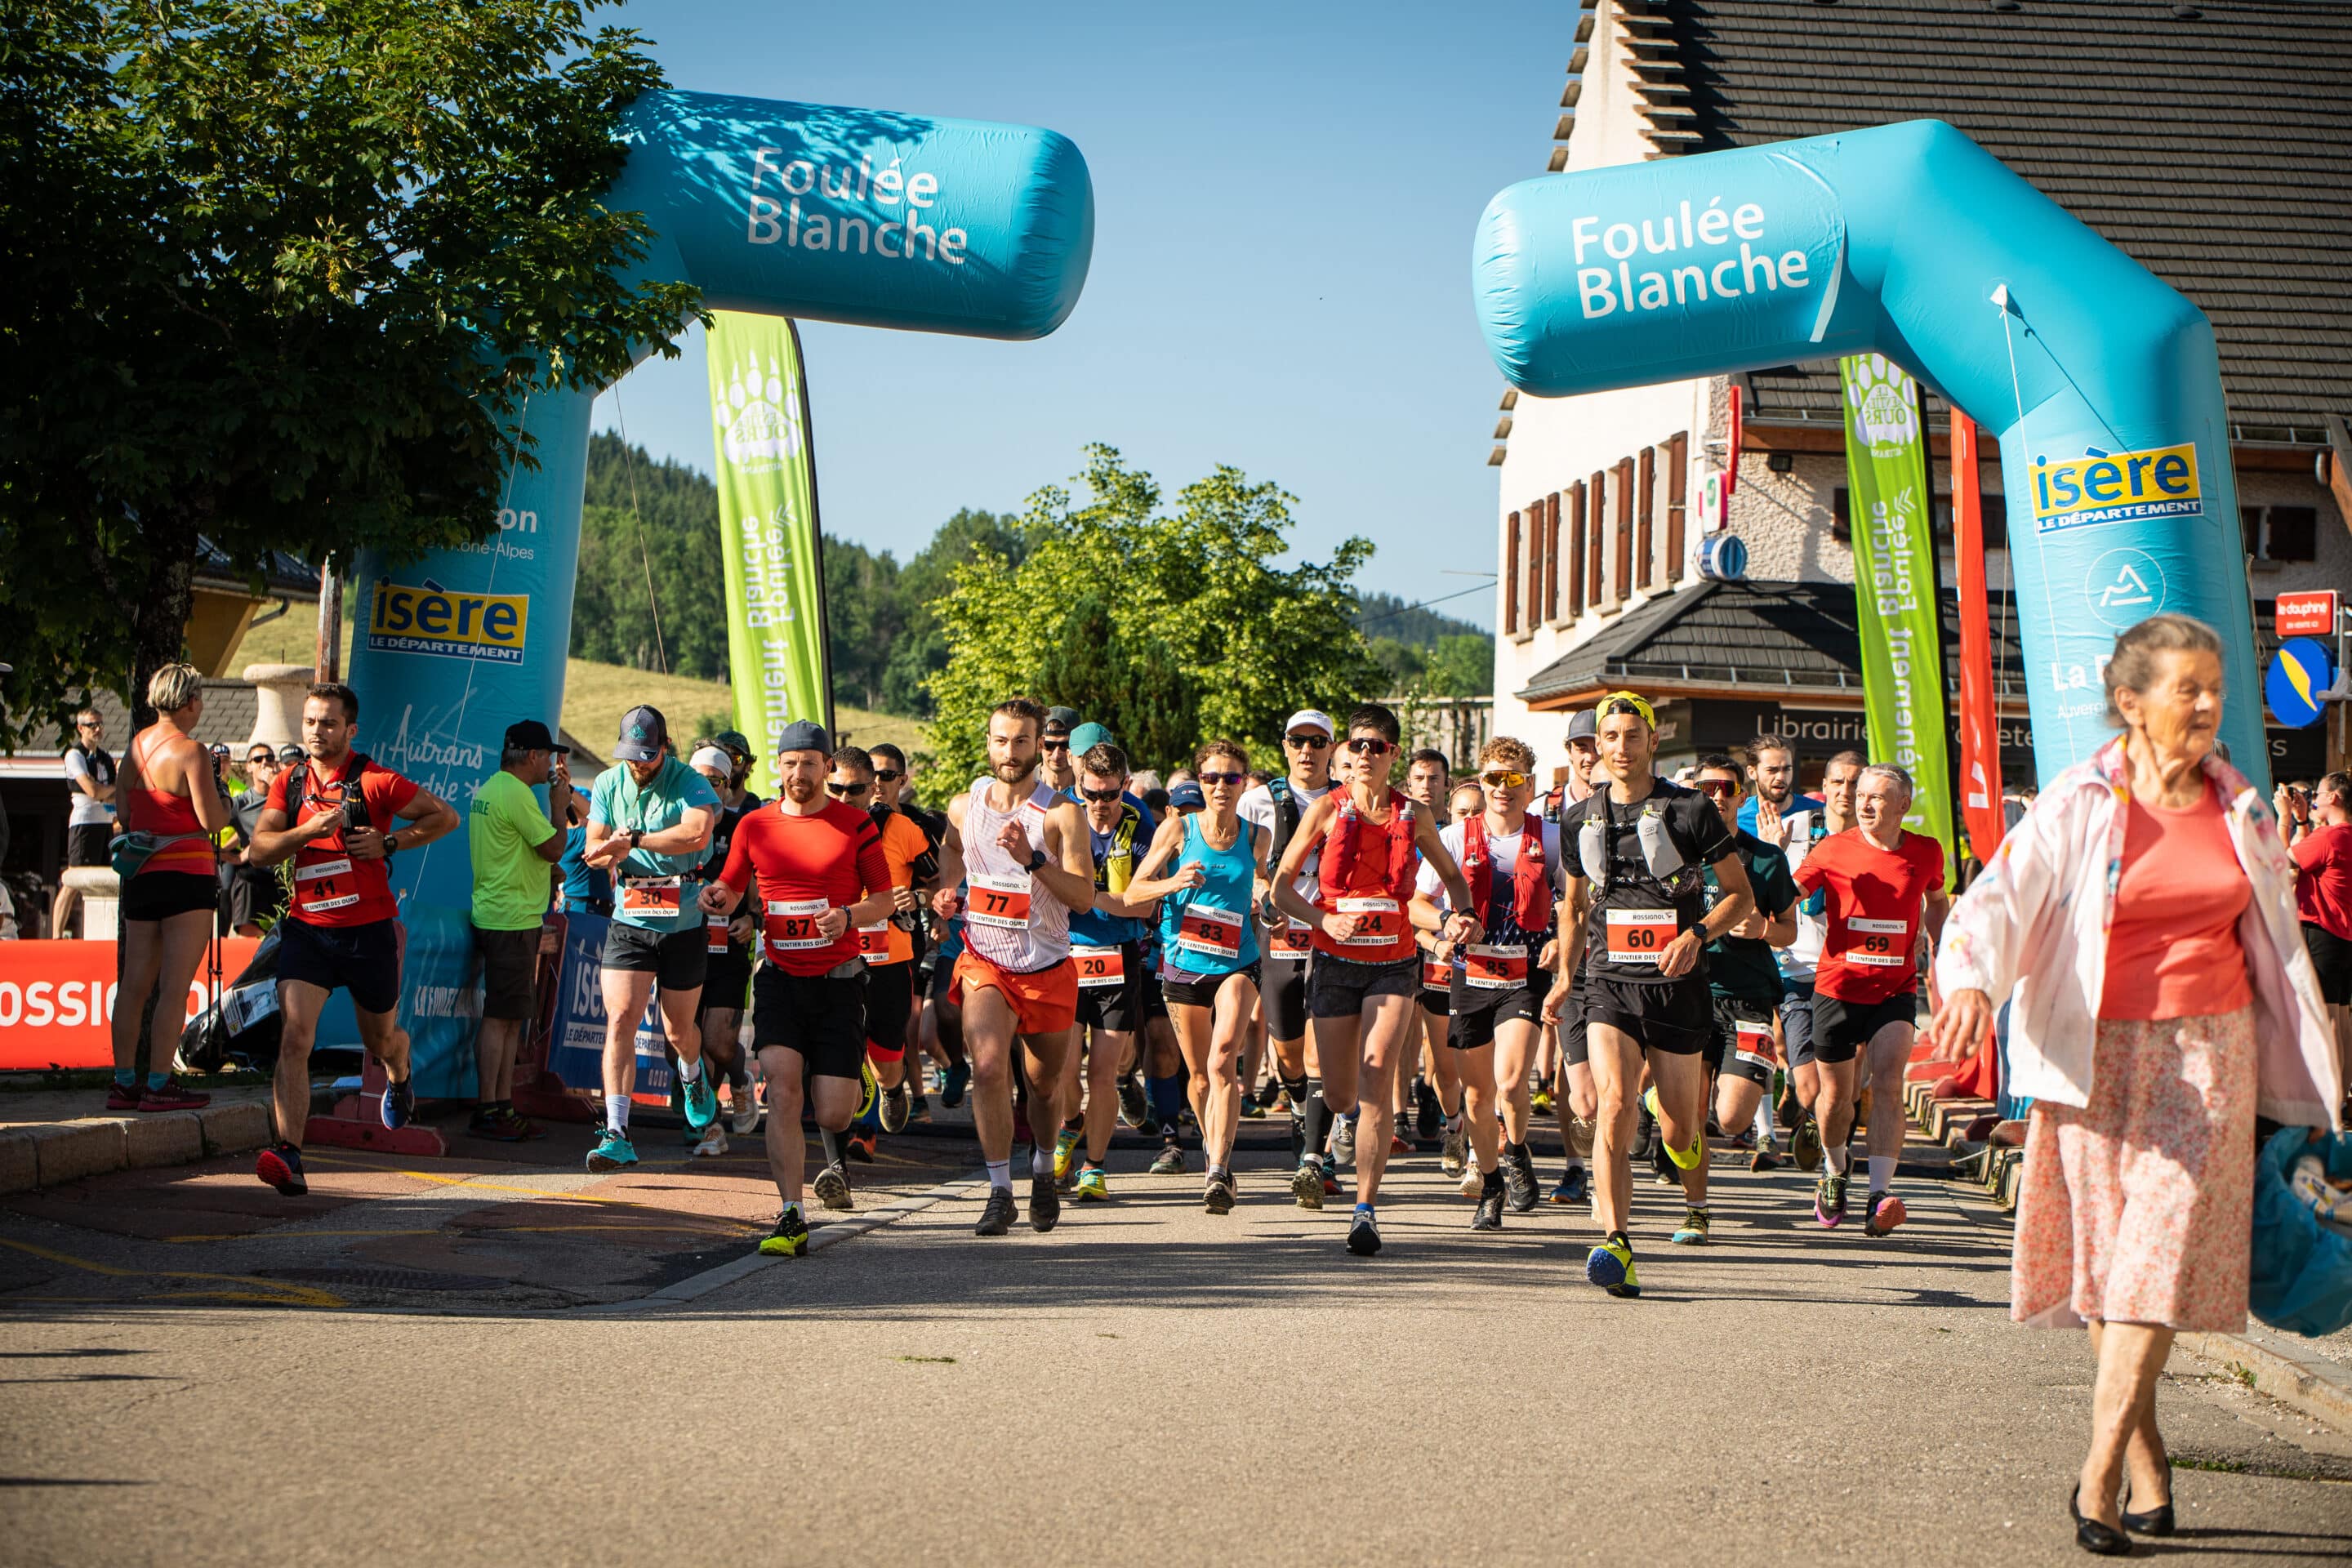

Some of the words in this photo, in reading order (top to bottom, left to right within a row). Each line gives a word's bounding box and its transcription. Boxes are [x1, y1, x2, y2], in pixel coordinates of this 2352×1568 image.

[752, 146, 938, 208] Foulée
[748, 196, 967, 264] Blanche
[1572, 196, 1764, 265] Foulée
[1577, 243, 1810, 318] Blanche
[2037, 446, 2190, 510] isère
[2038, 519, 2056, 531] LE
[2058, 500, 2200, 528] DÉPARTEMENT
[376, 575, 518, 642] isère
[370, 637, 385, 648] LE
[387, 637, 521, 660] DÉPARTEMENT
[389, 704, 482, 770] Autrans
[314, 879, 336, 897] 41
[640, 891, 662, 905] 30
[986, 893, 1009, 912] 77
[786, 919, 810, 936] 87
[1199, 923, 1223, 942] 83
[1360, 915, 1383, 932] 24
[860, 935, 871, 951] 3
[1288, 933, 1310, 947] 52
[1627, 929, 1655, 948] 60
[1865, 936, 1889, 952] 69
[1209, 946, 1220, 954] DES
[1221, 948, 1236, 957] OURS
[1084, 960, 1106, 974] 20
[1486, 960, 1508, 977] 85
[565, 1028, 573, 1040] LE
[1757, 1036, 1772, 1057] 68
